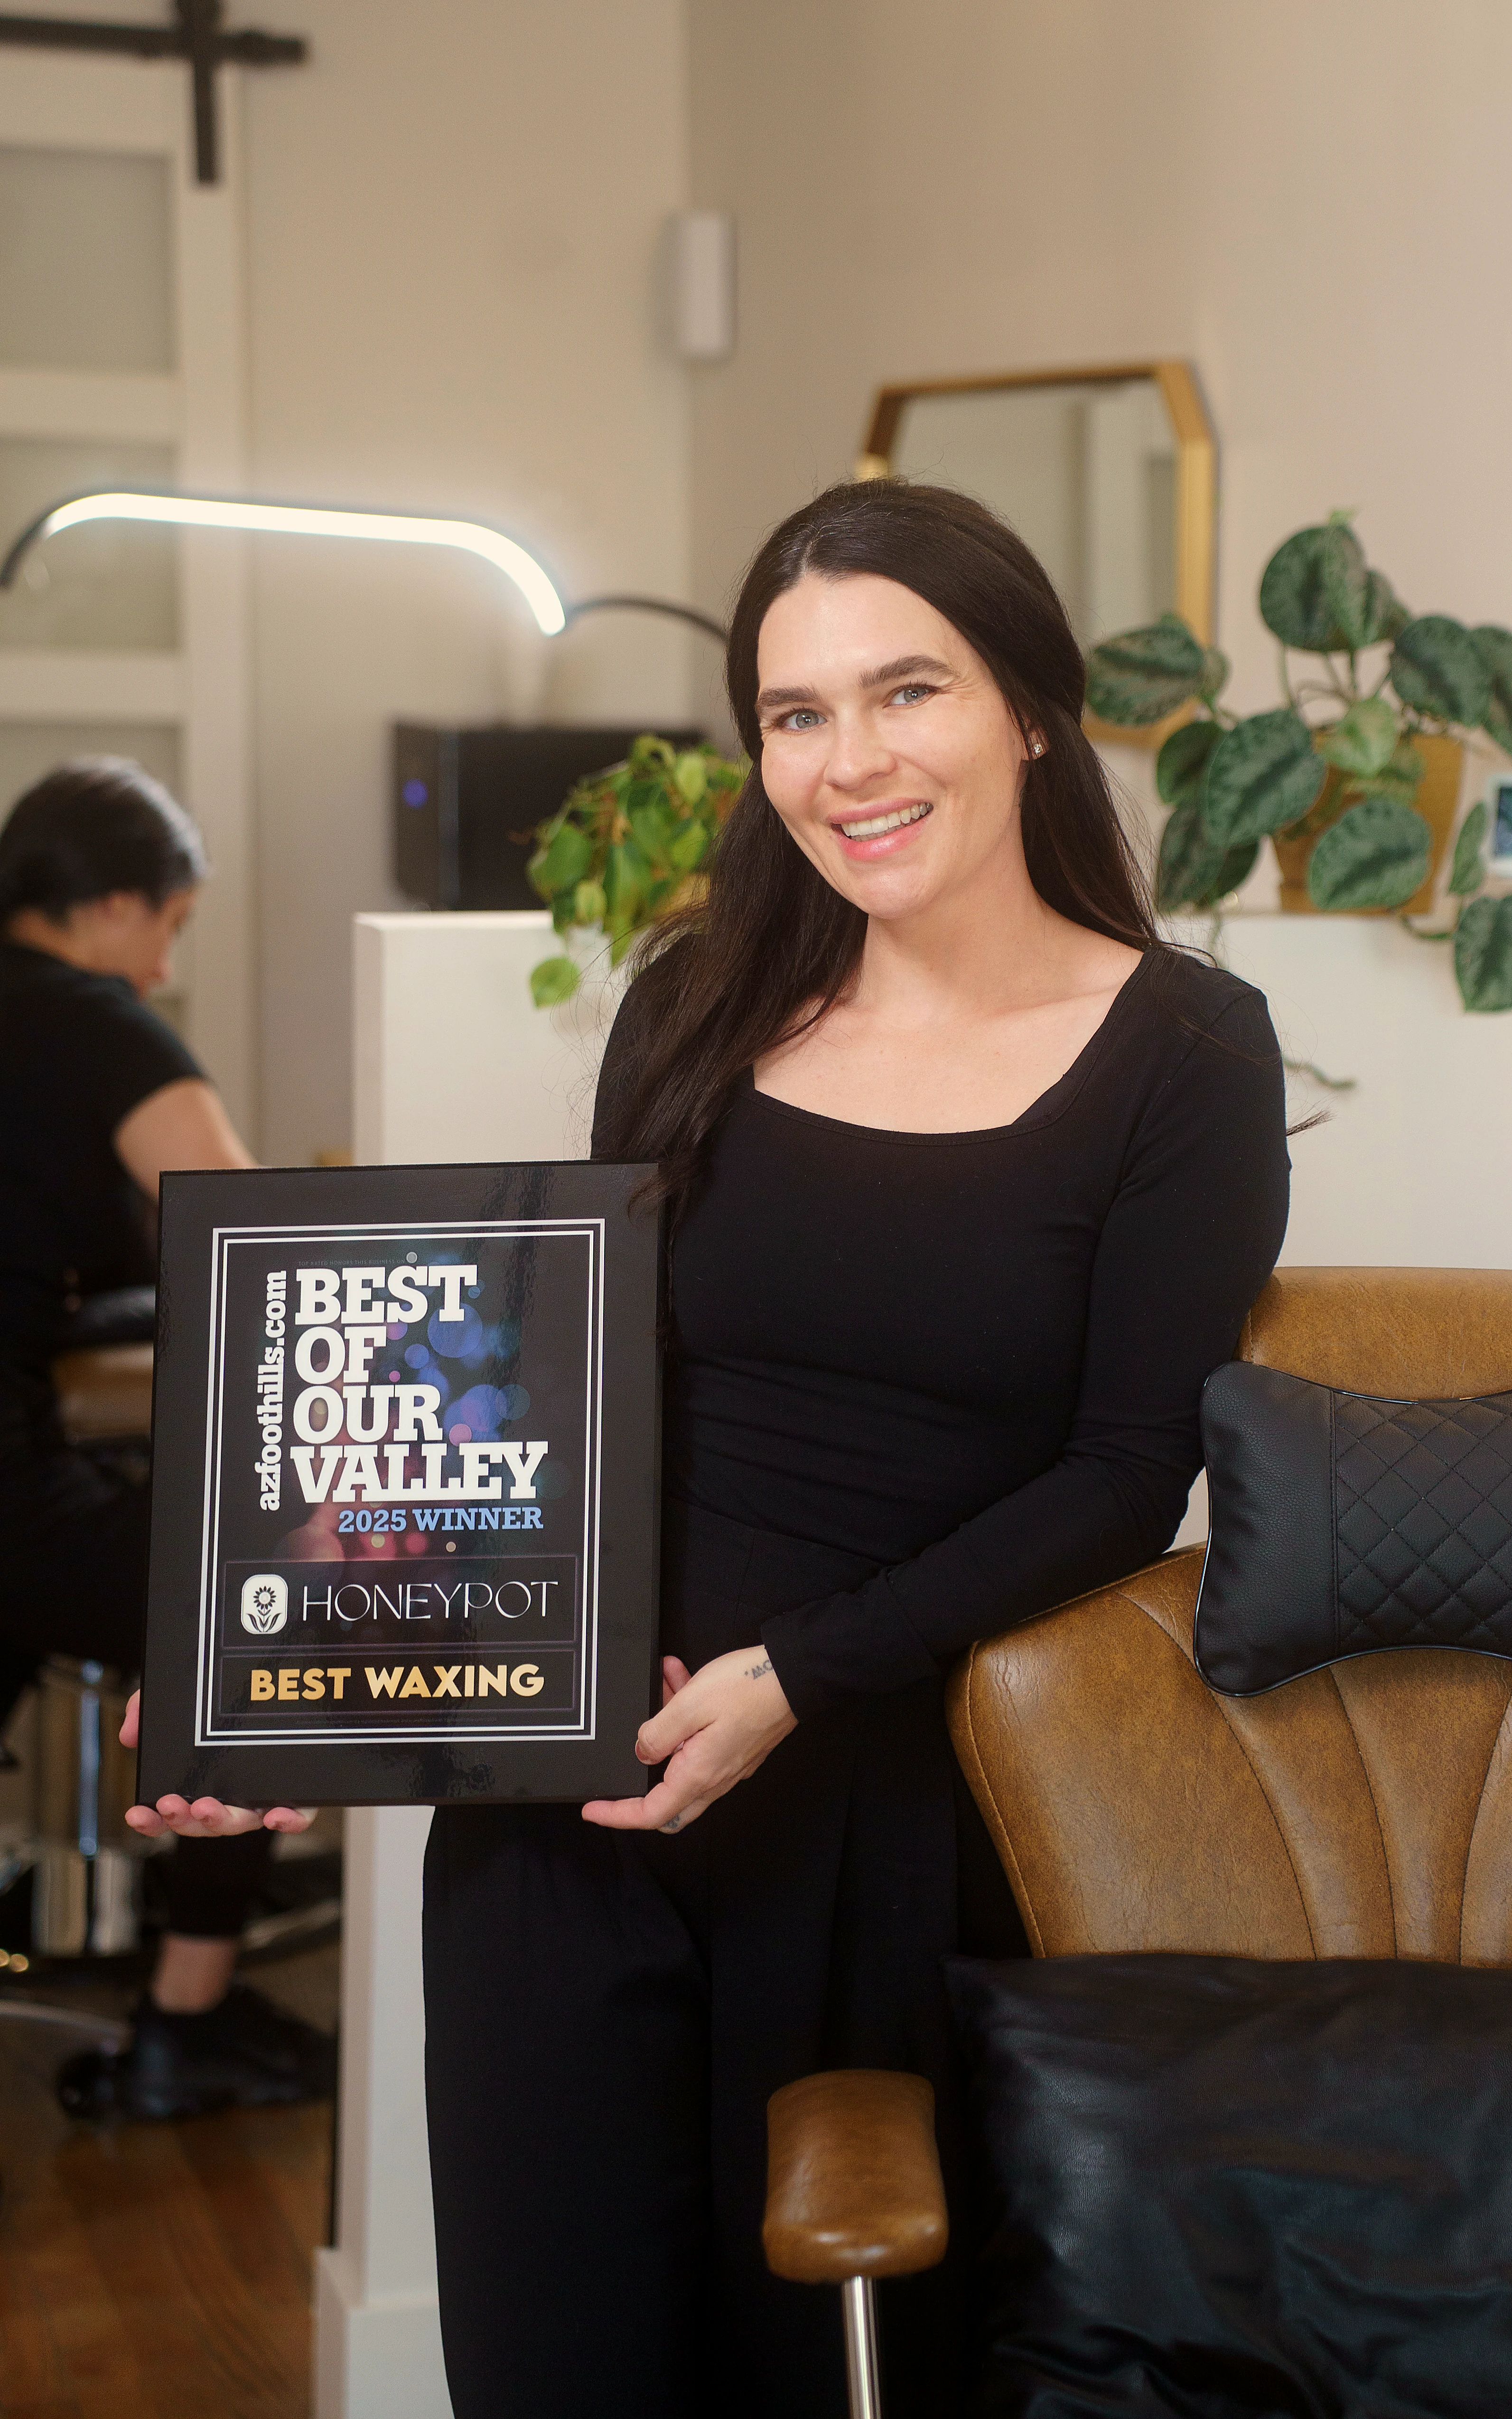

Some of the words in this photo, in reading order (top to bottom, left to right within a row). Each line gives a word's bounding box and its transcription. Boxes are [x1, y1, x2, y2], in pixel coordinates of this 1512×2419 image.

[295, 1265, 477, 1325] BEST
[295, 1326, 387, 1384] OF
[255, 1270, 287, 1511] azfoothills.com
[293, 1384, 443, 1444] OUR
[290, 1441, 548, 1504] VALLEY
[338, 1509, 407, 1532] 2025
[412, 1506, 544, 1531] WINNER
[302, 1580, 559, 1622] HONEYPOT
[251, 1668, 351, 1700] BEST
[364, 1663, 544, 1699] WAXING
